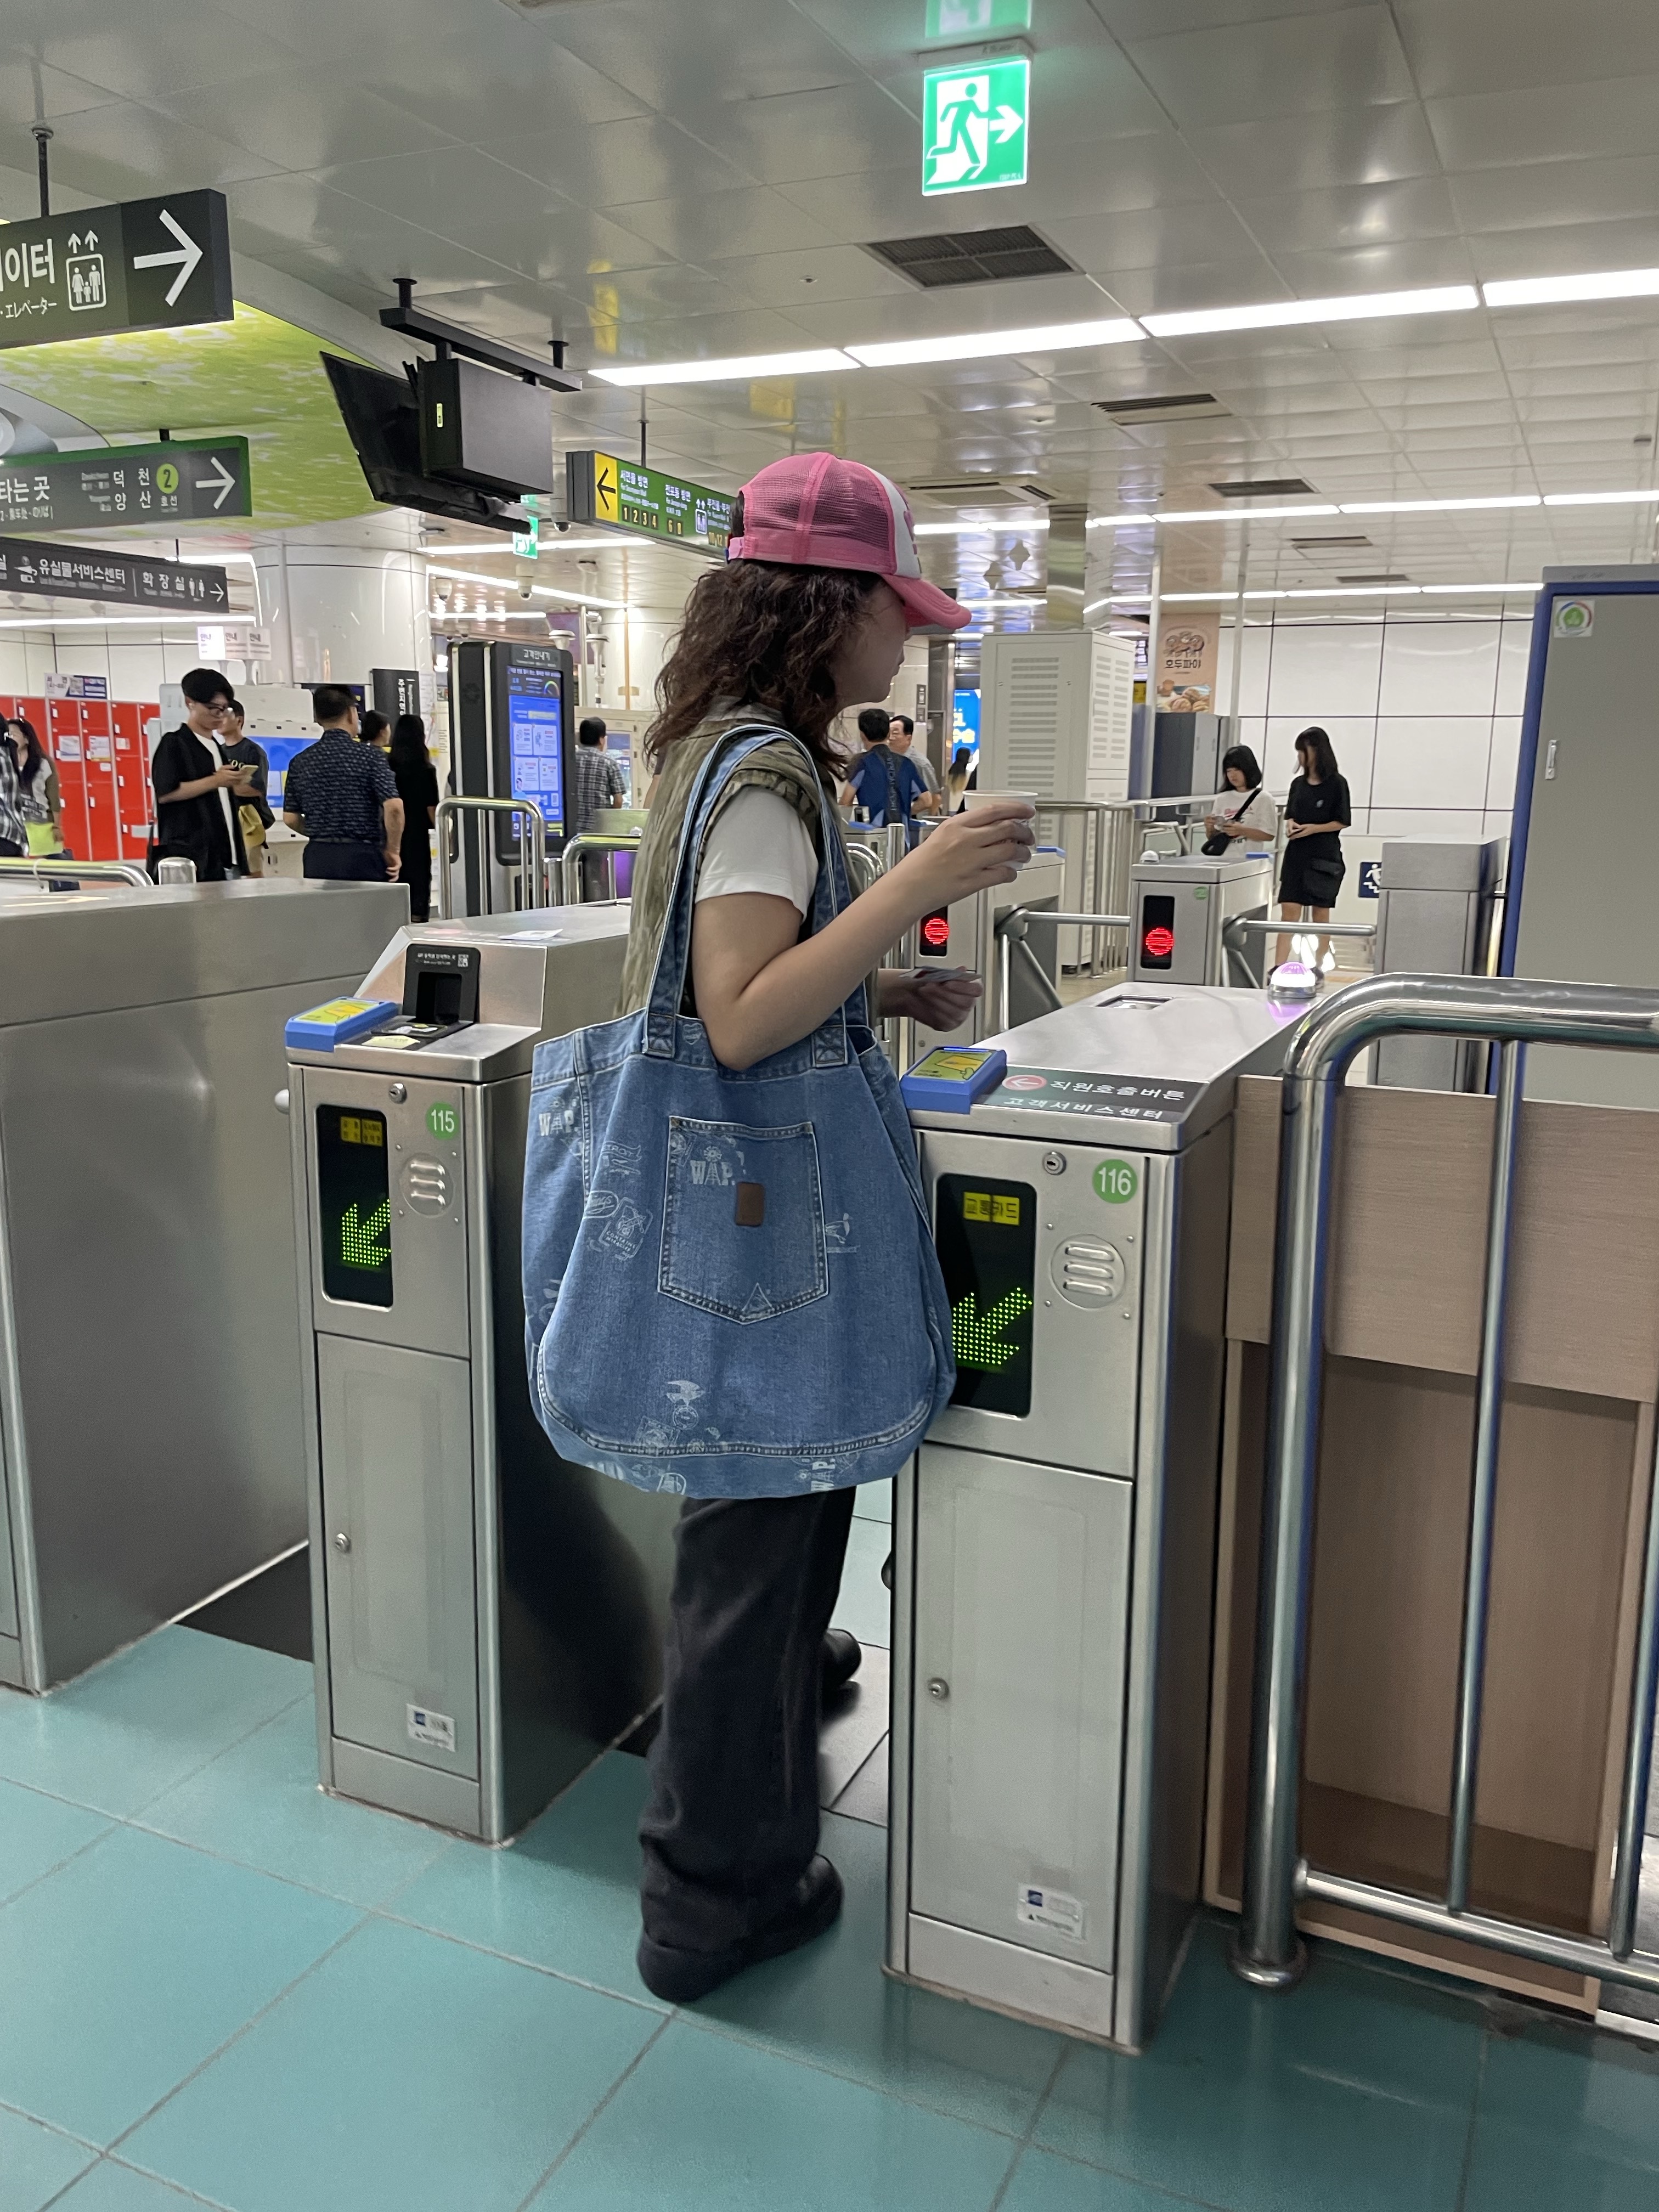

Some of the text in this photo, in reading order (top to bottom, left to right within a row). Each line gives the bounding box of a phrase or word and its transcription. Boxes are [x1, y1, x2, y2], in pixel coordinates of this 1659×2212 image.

[0, 239, 55, 291] 이터
[34, 476, 50, 501] 곳
[163, 469, 172, 488] 2
[115, 491, 151, 511] 양산
[624, 507, 657, 528] 1 2 3 4
[668, 520, 673, 532] 6
[143, 572, 185, 591] 화장실
[1050, 1080, 1184, 1101] 직원호출버튼
[1003, 1098, 1164, 1119] 고객서비스센터
[431, 1109, 454, 1133] 115
[1098, 1167, 1131, 1195] 116
